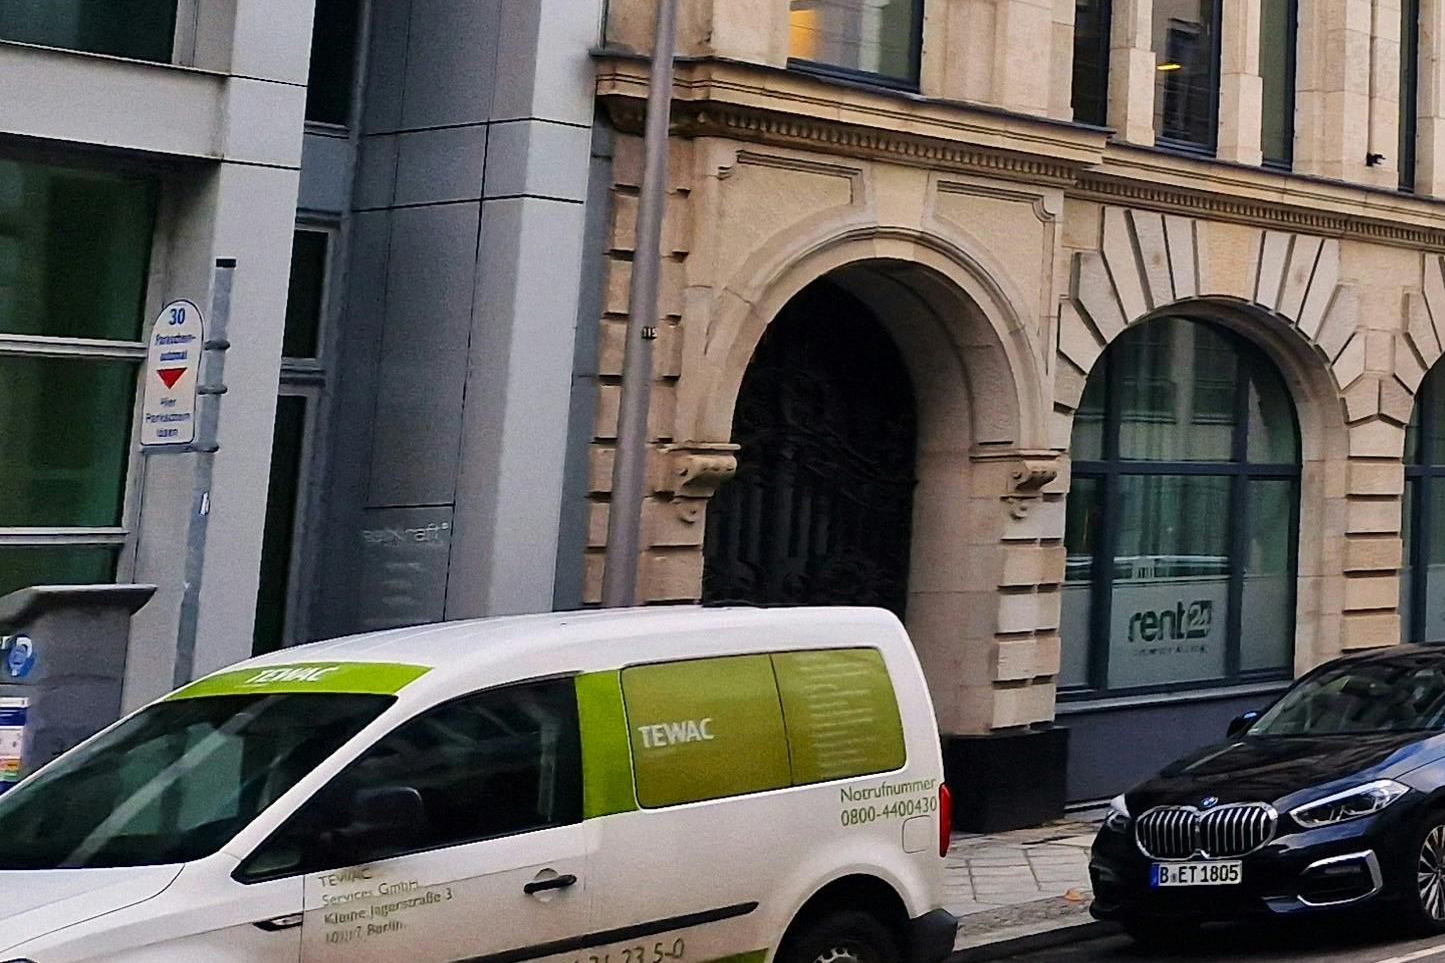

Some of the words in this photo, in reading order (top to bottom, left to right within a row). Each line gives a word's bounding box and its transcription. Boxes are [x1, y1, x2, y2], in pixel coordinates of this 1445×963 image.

[168, 307, 186, 326] 30
[244, 667, 340, 684] TEWAC
[637, 718, 715, 749] TEWAC
[840, 778, 937, 804] Notrufnummer
[840, 796, 937, 827] 0800-4400430
[1160, 867, 1169, 883] B
[1178, 866, 1198, 883] ET
[1200, 865, 1239, 883] 1805
[445, 887, 453, 901] 3
